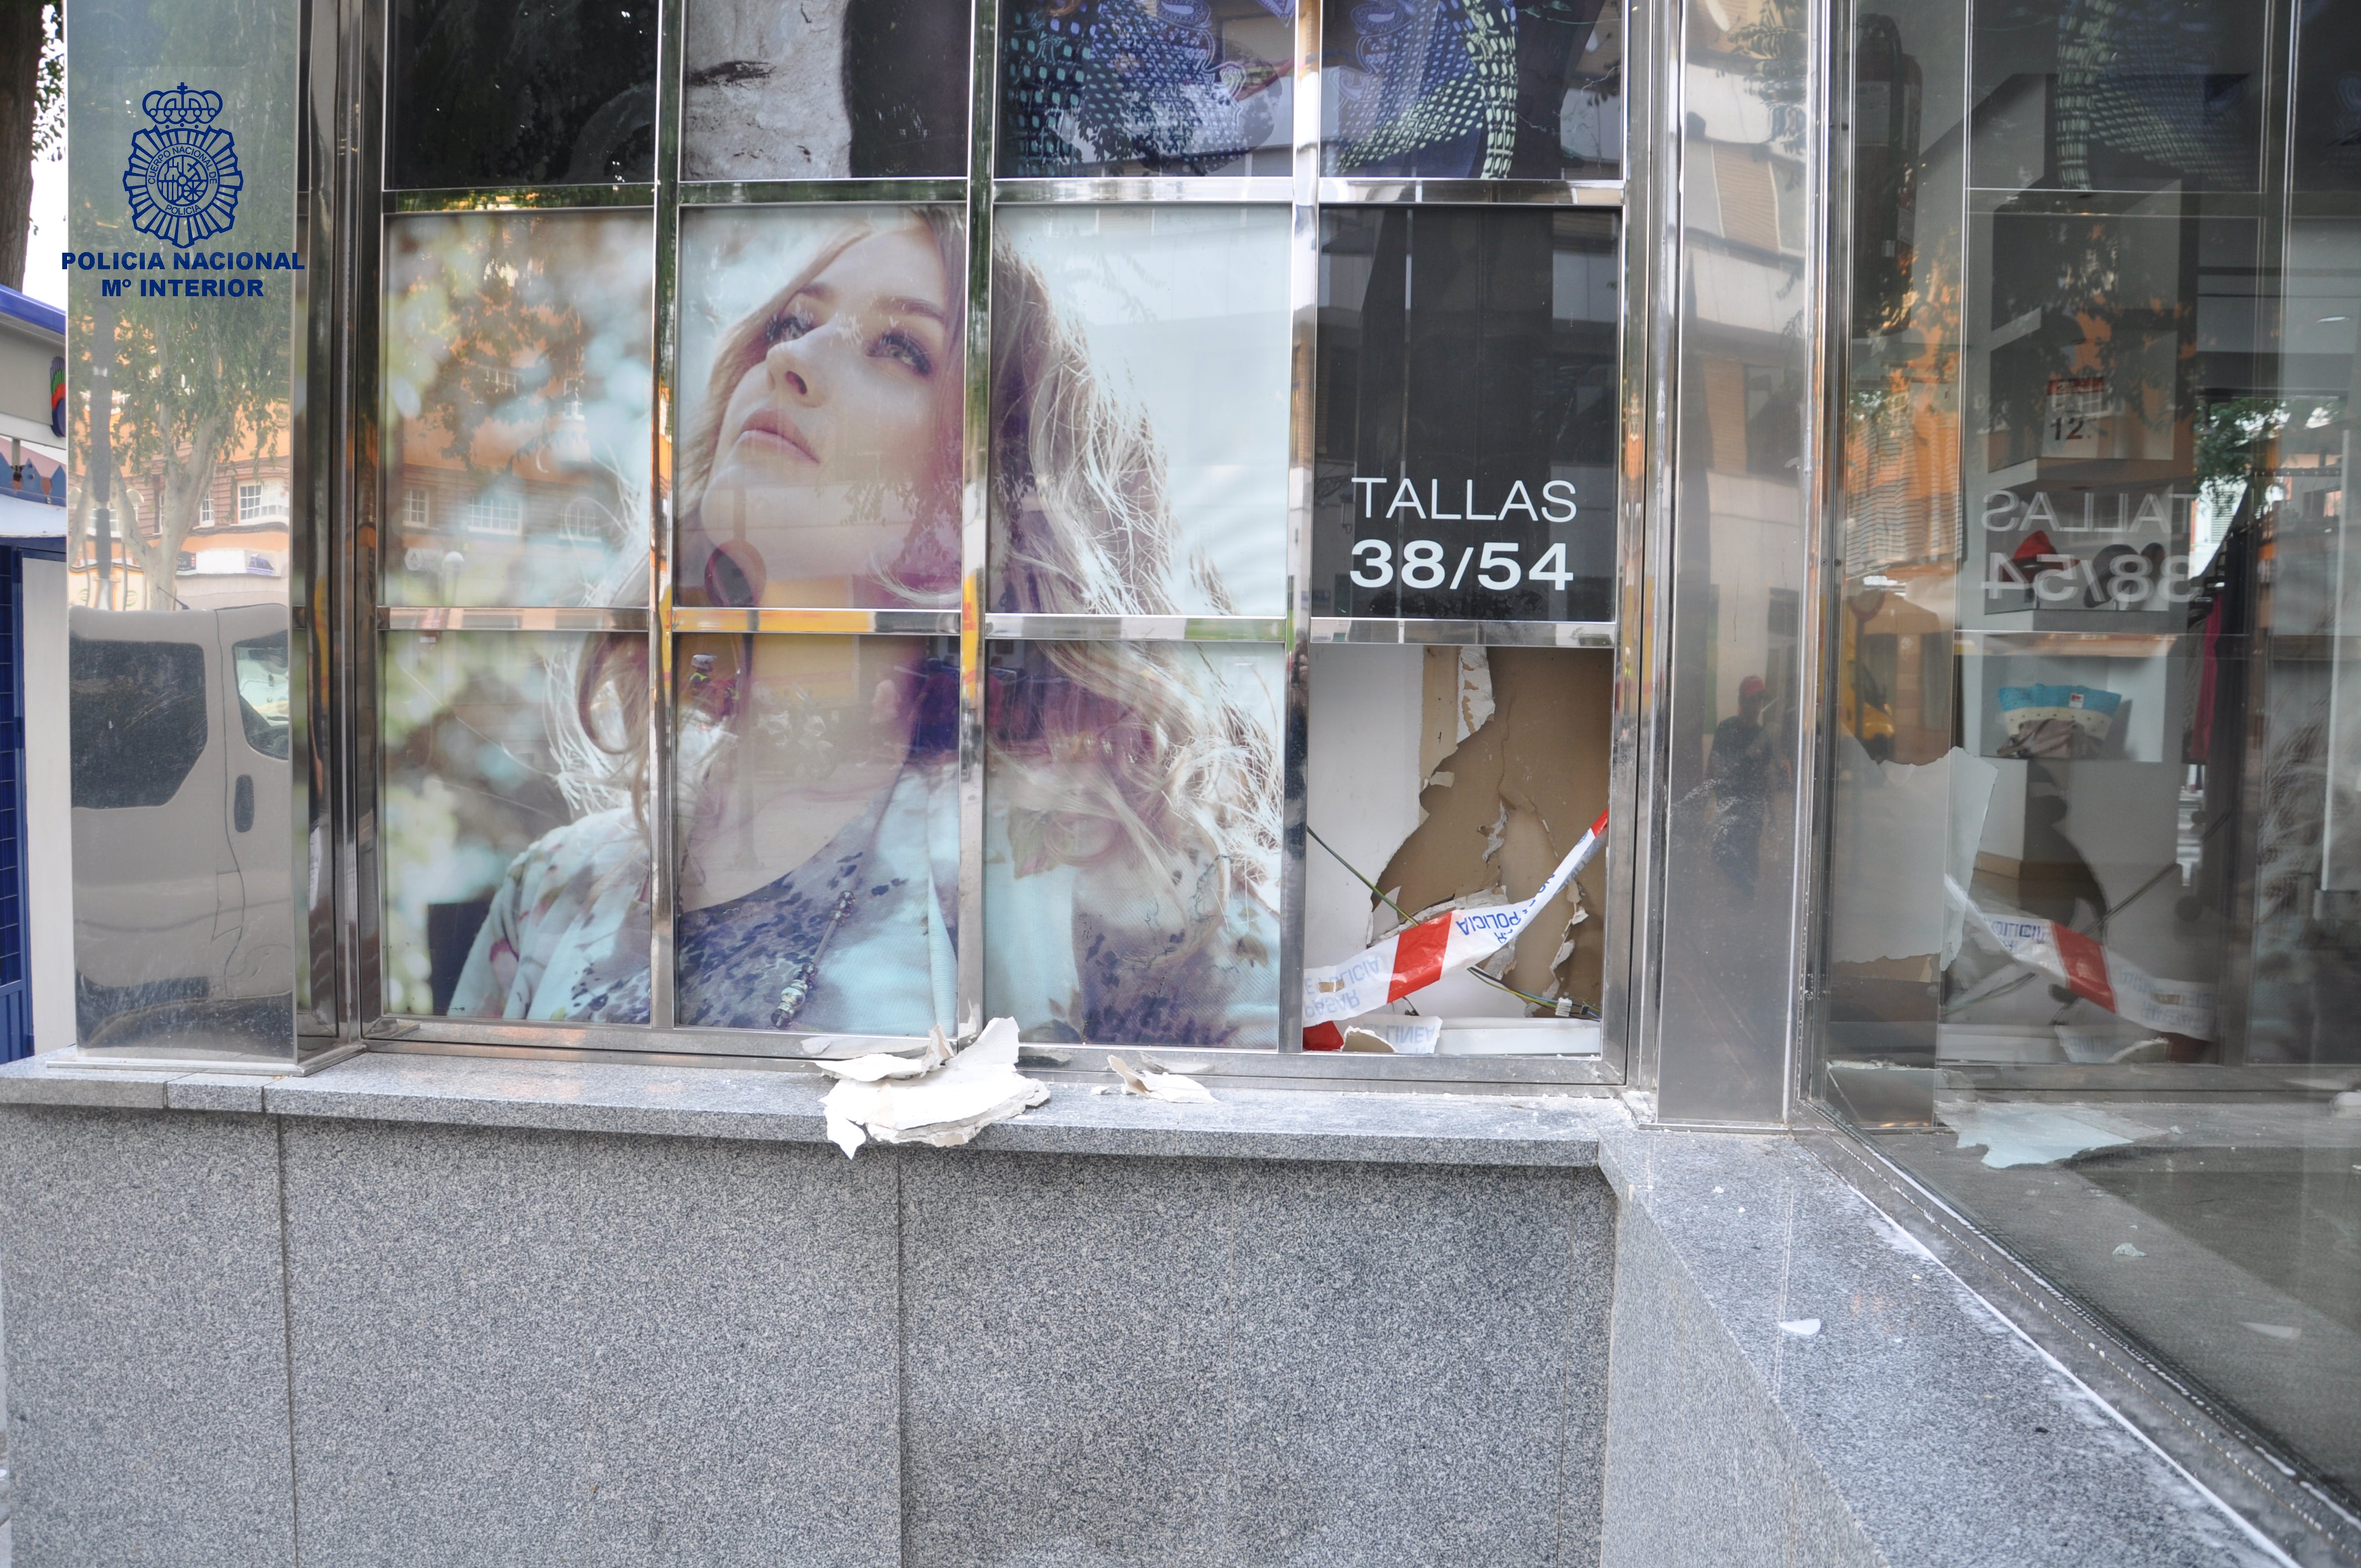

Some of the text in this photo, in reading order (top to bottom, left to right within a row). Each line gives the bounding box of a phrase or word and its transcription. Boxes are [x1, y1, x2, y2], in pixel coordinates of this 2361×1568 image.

[1351, 477, 1577, 522] TALLAS
[1350, 539, 1574, 591] 38/54
[1455, 910, 1522, 936] POLICIA
